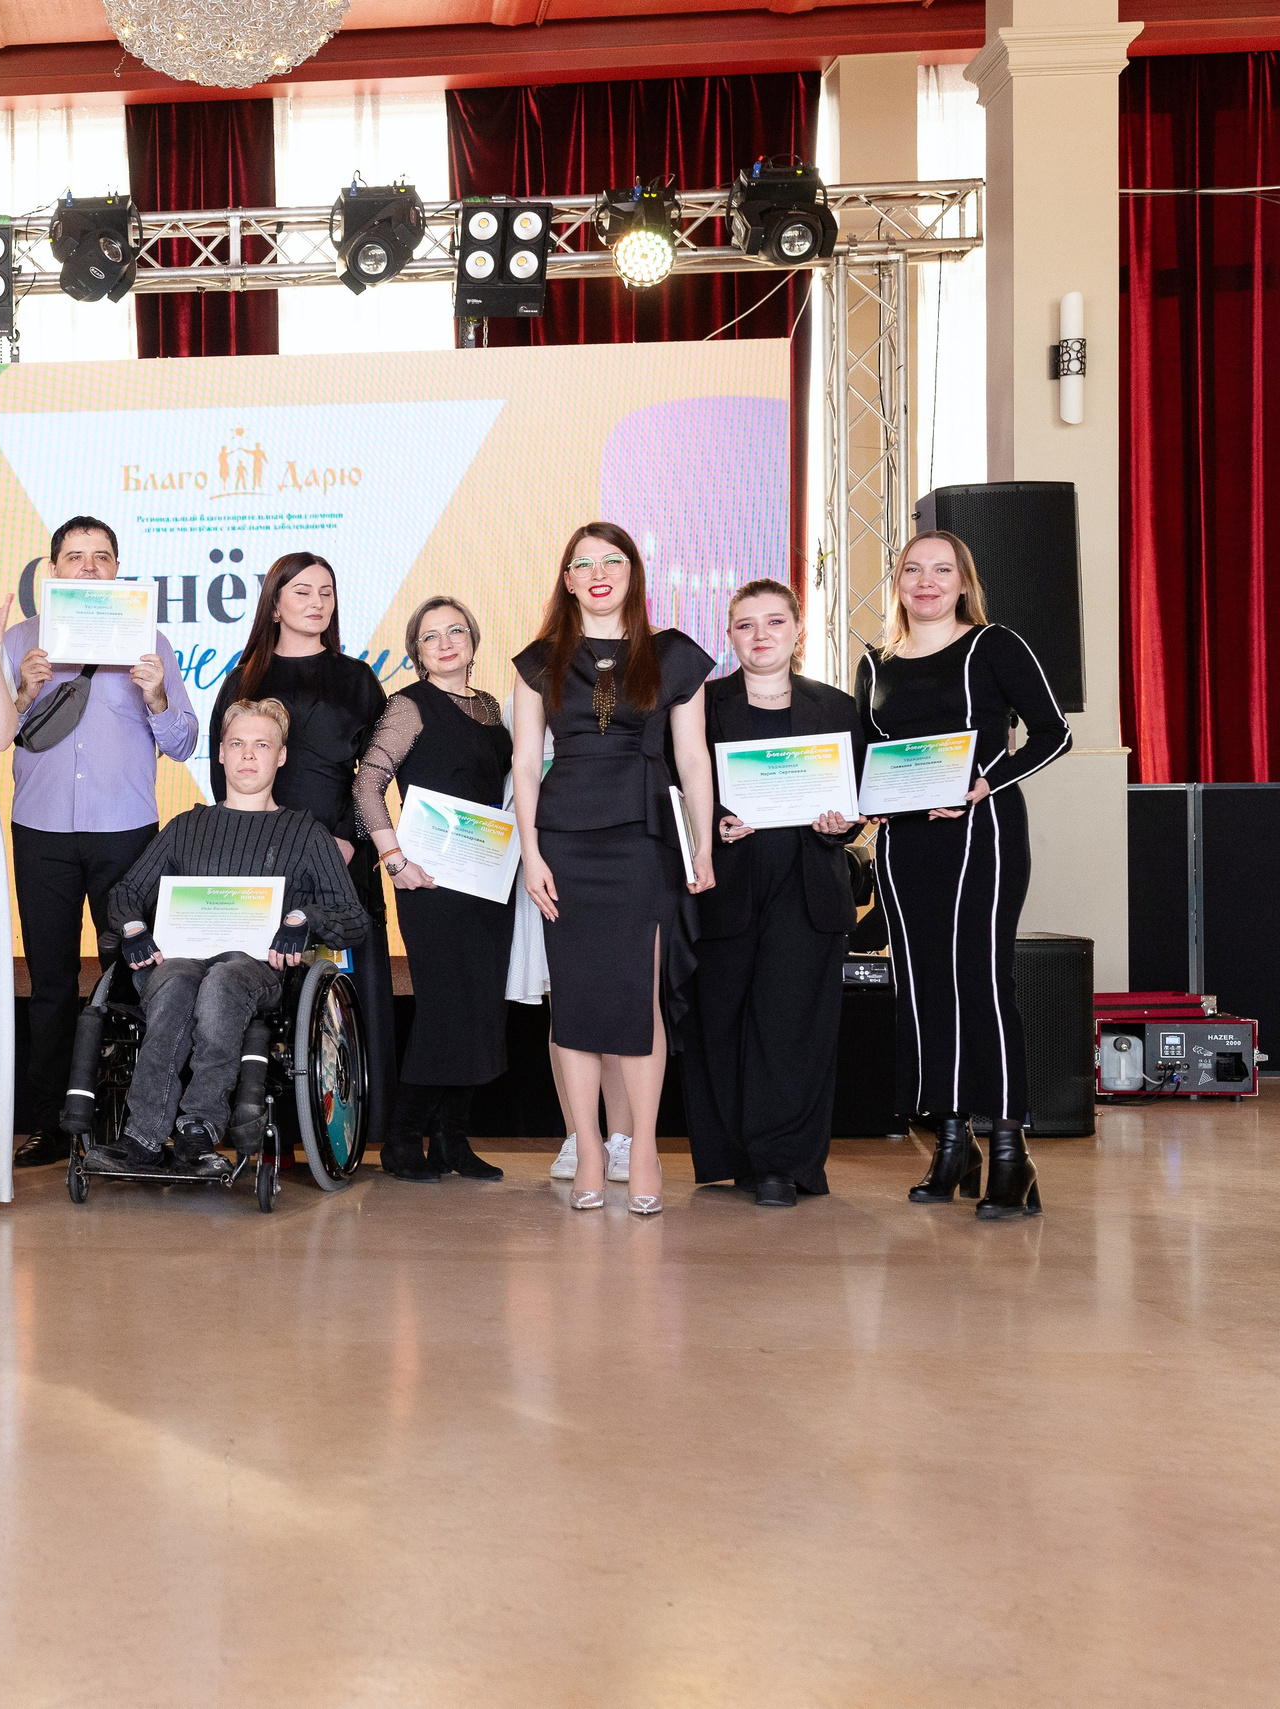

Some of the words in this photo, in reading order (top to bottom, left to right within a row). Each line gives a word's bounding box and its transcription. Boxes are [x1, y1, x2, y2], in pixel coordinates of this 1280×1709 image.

[121, 465, 208, 491] Благо
[278, 461, 362, 495] Дарю
[765, 745, 835, 760] Благодарственное
